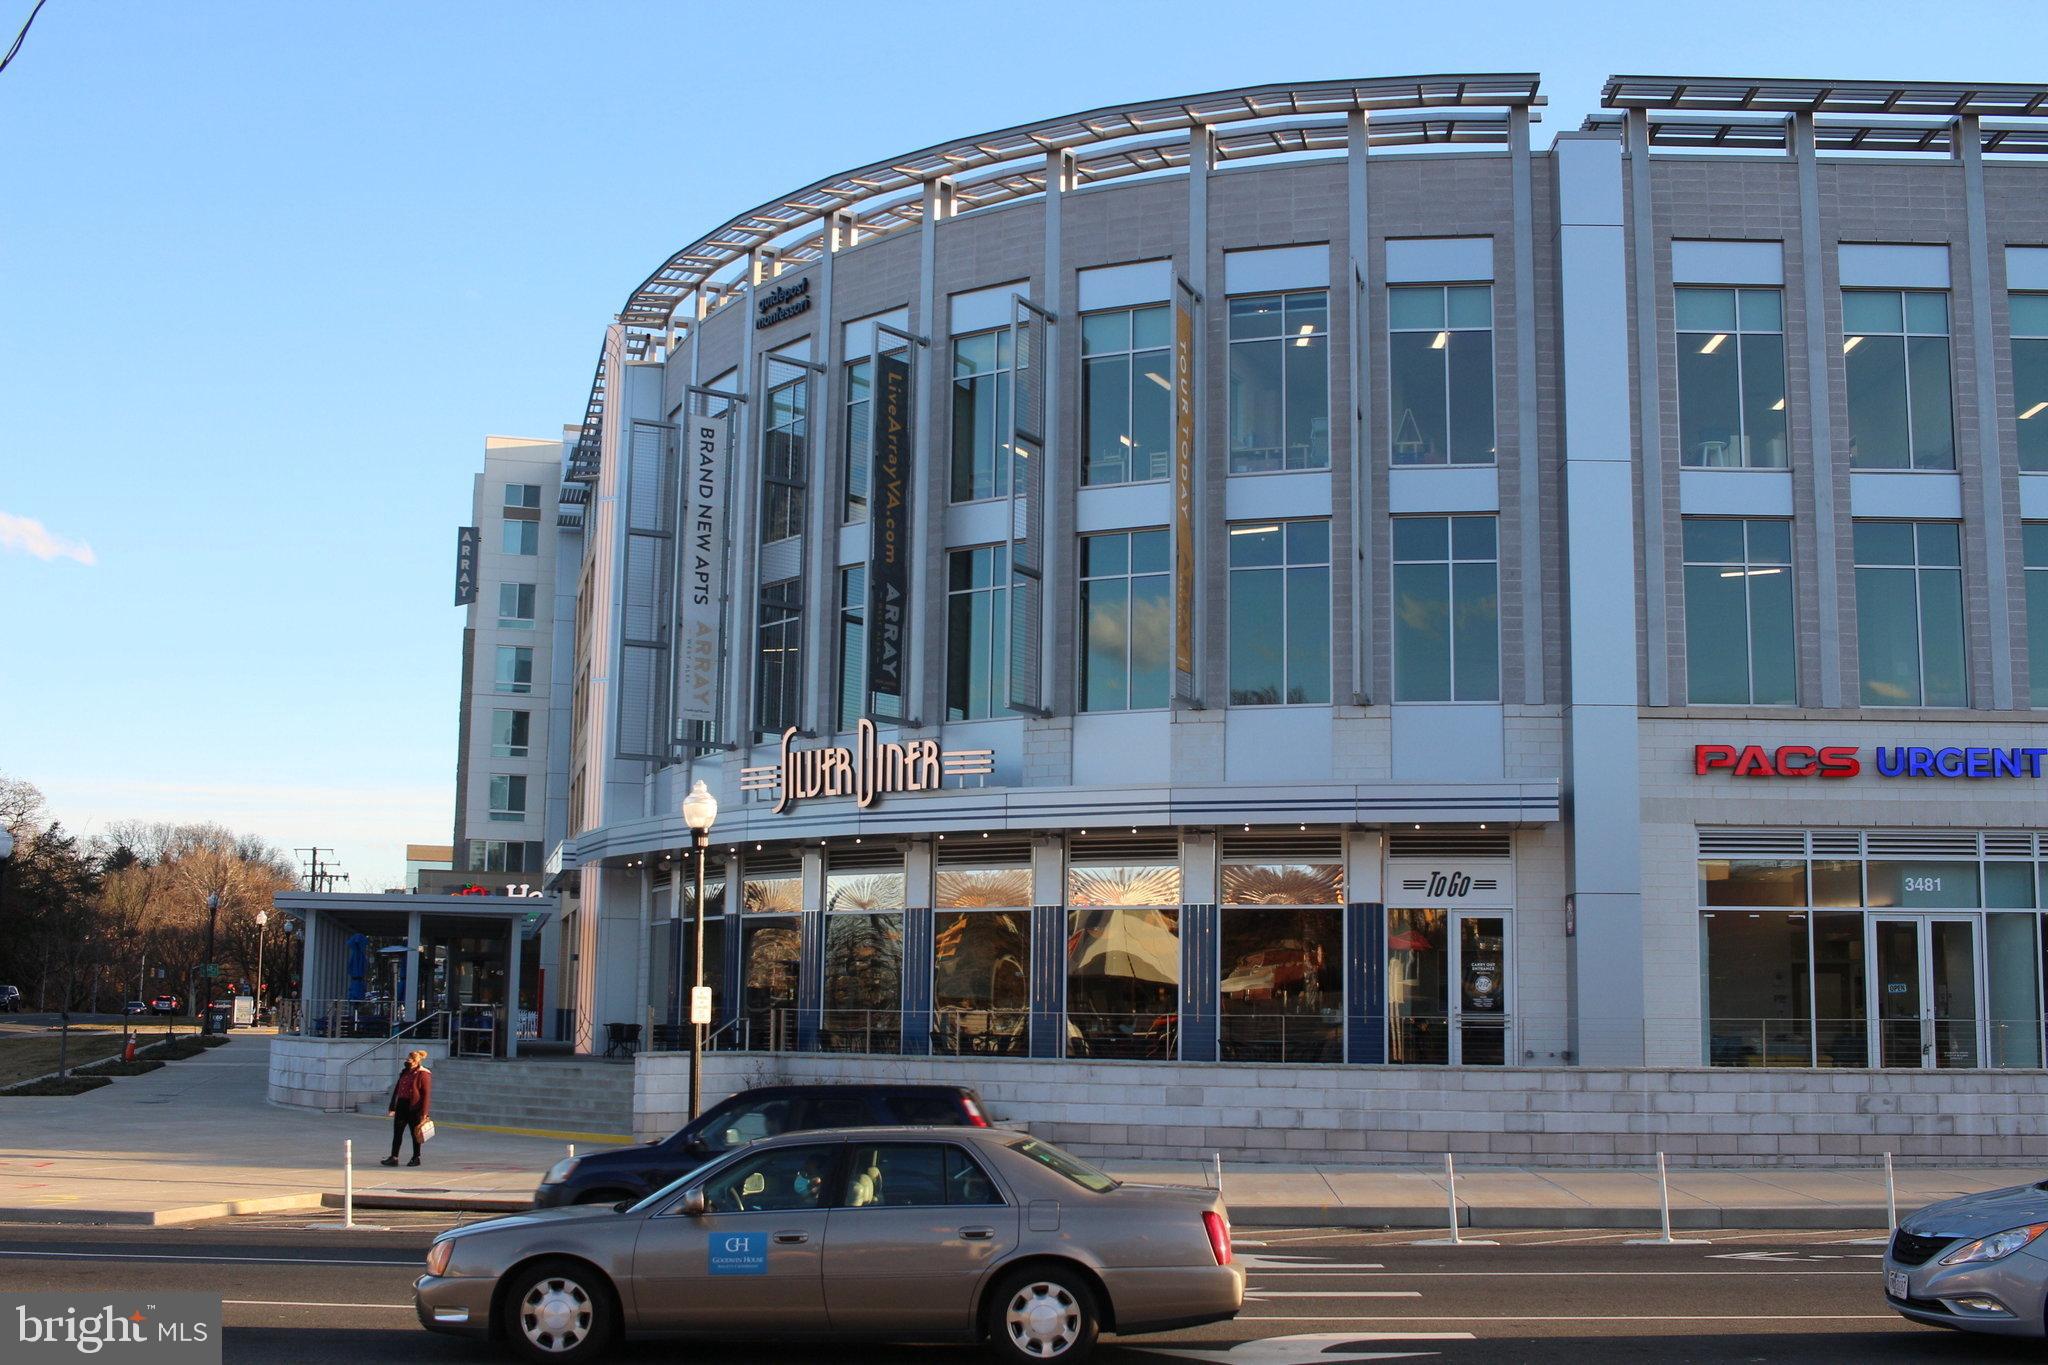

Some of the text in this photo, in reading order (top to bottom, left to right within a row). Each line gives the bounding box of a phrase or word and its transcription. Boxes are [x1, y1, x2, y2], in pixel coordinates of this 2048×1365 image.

[756, 295, 811, 330] montessori
[758, 277, 808, 314] guidepost
[883, 372, 902, 564] LiveArrayVA.com
[1179, 341, 1189, 520] TOUR TODAY
[694, 427, 715, 606] BRAND NEW APTS
[459, 531, 472, 597] ARRAY
[693, 620, 713, 706] ARRAY
[882, 582, 900, 679] ARRAY
[771, 718, 940, 814] SILVER DINER
[1695, 744, 2048, 779] PACS URGENT
[1905, 878, 1941, 892] 3481
[725, 1237, 750, 1252] GH
